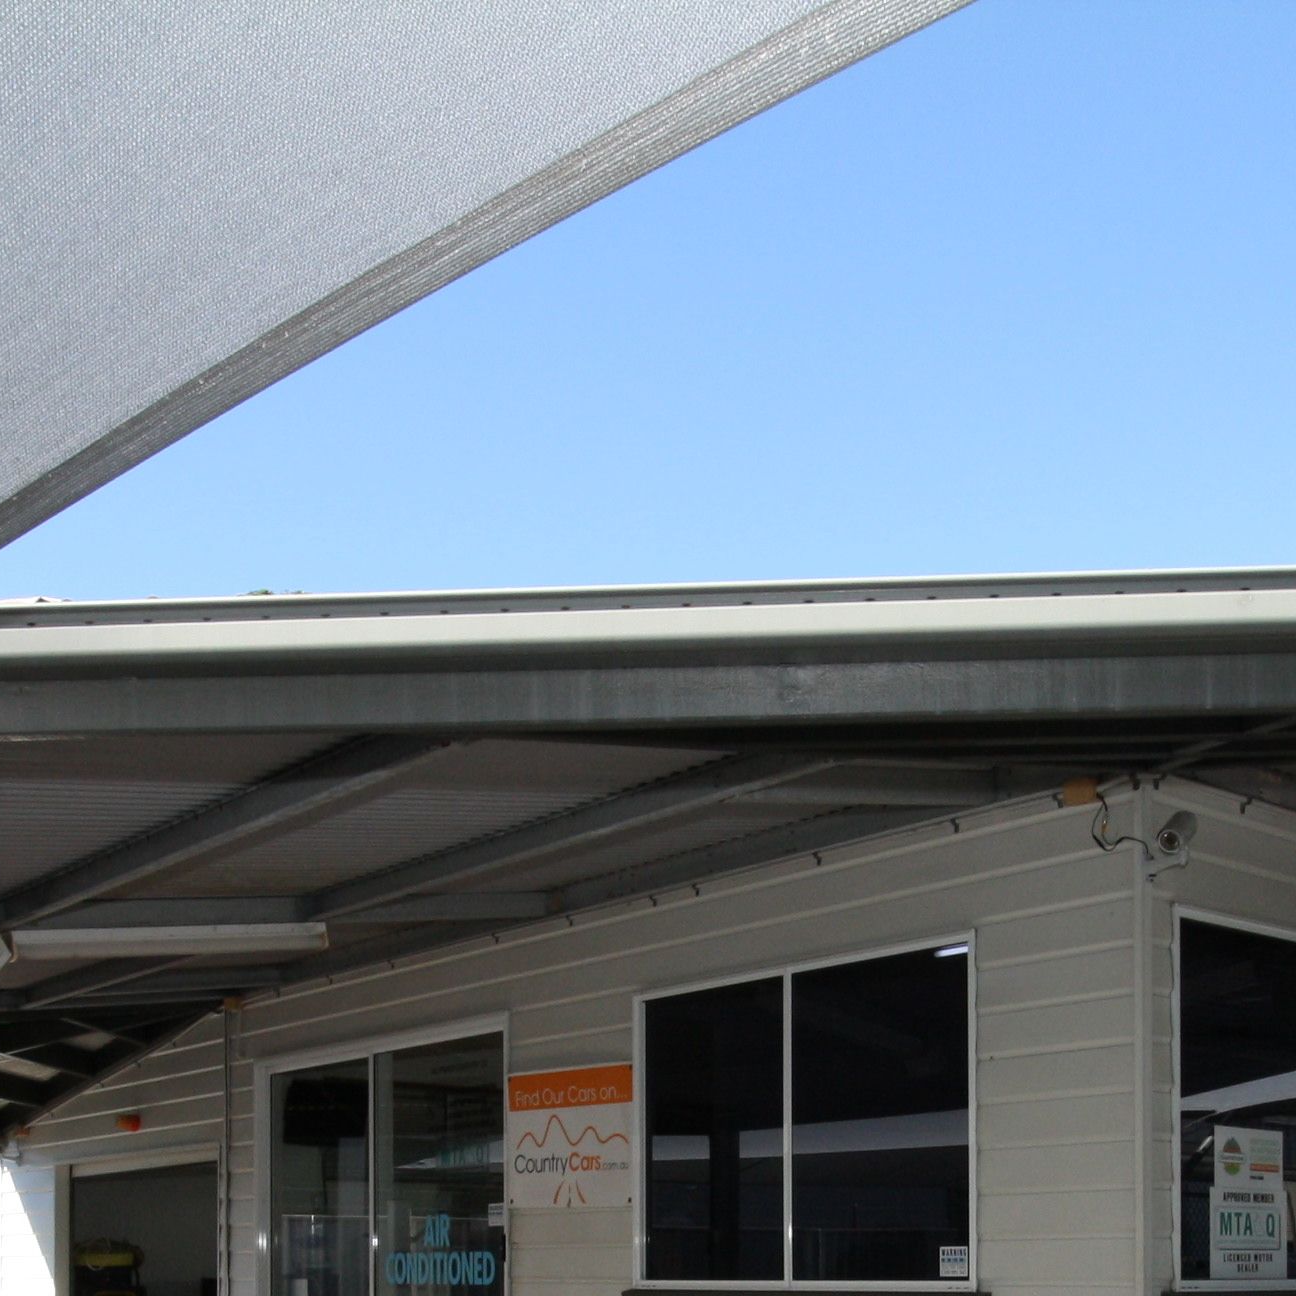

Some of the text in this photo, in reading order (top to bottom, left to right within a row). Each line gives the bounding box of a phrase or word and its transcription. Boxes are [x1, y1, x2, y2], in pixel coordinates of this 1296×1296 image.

[515, 1090, 540, 1108] Find
[542, 1087, 565, 1105] Our
[567, 1086, 597, 1103] Cars
[1223, 1191, 1275, 1204] APPROVED MEMBER
[424, 1213, 451, 1247] AIR
[1220, 1211, 1275, 1239] MTA Q
[386, 1250, 496, 1286] CONDITIONED
[1237, 1263, 1259, 1273] DEALER
[1253, 1253, 1273, 1263] MOTOR
